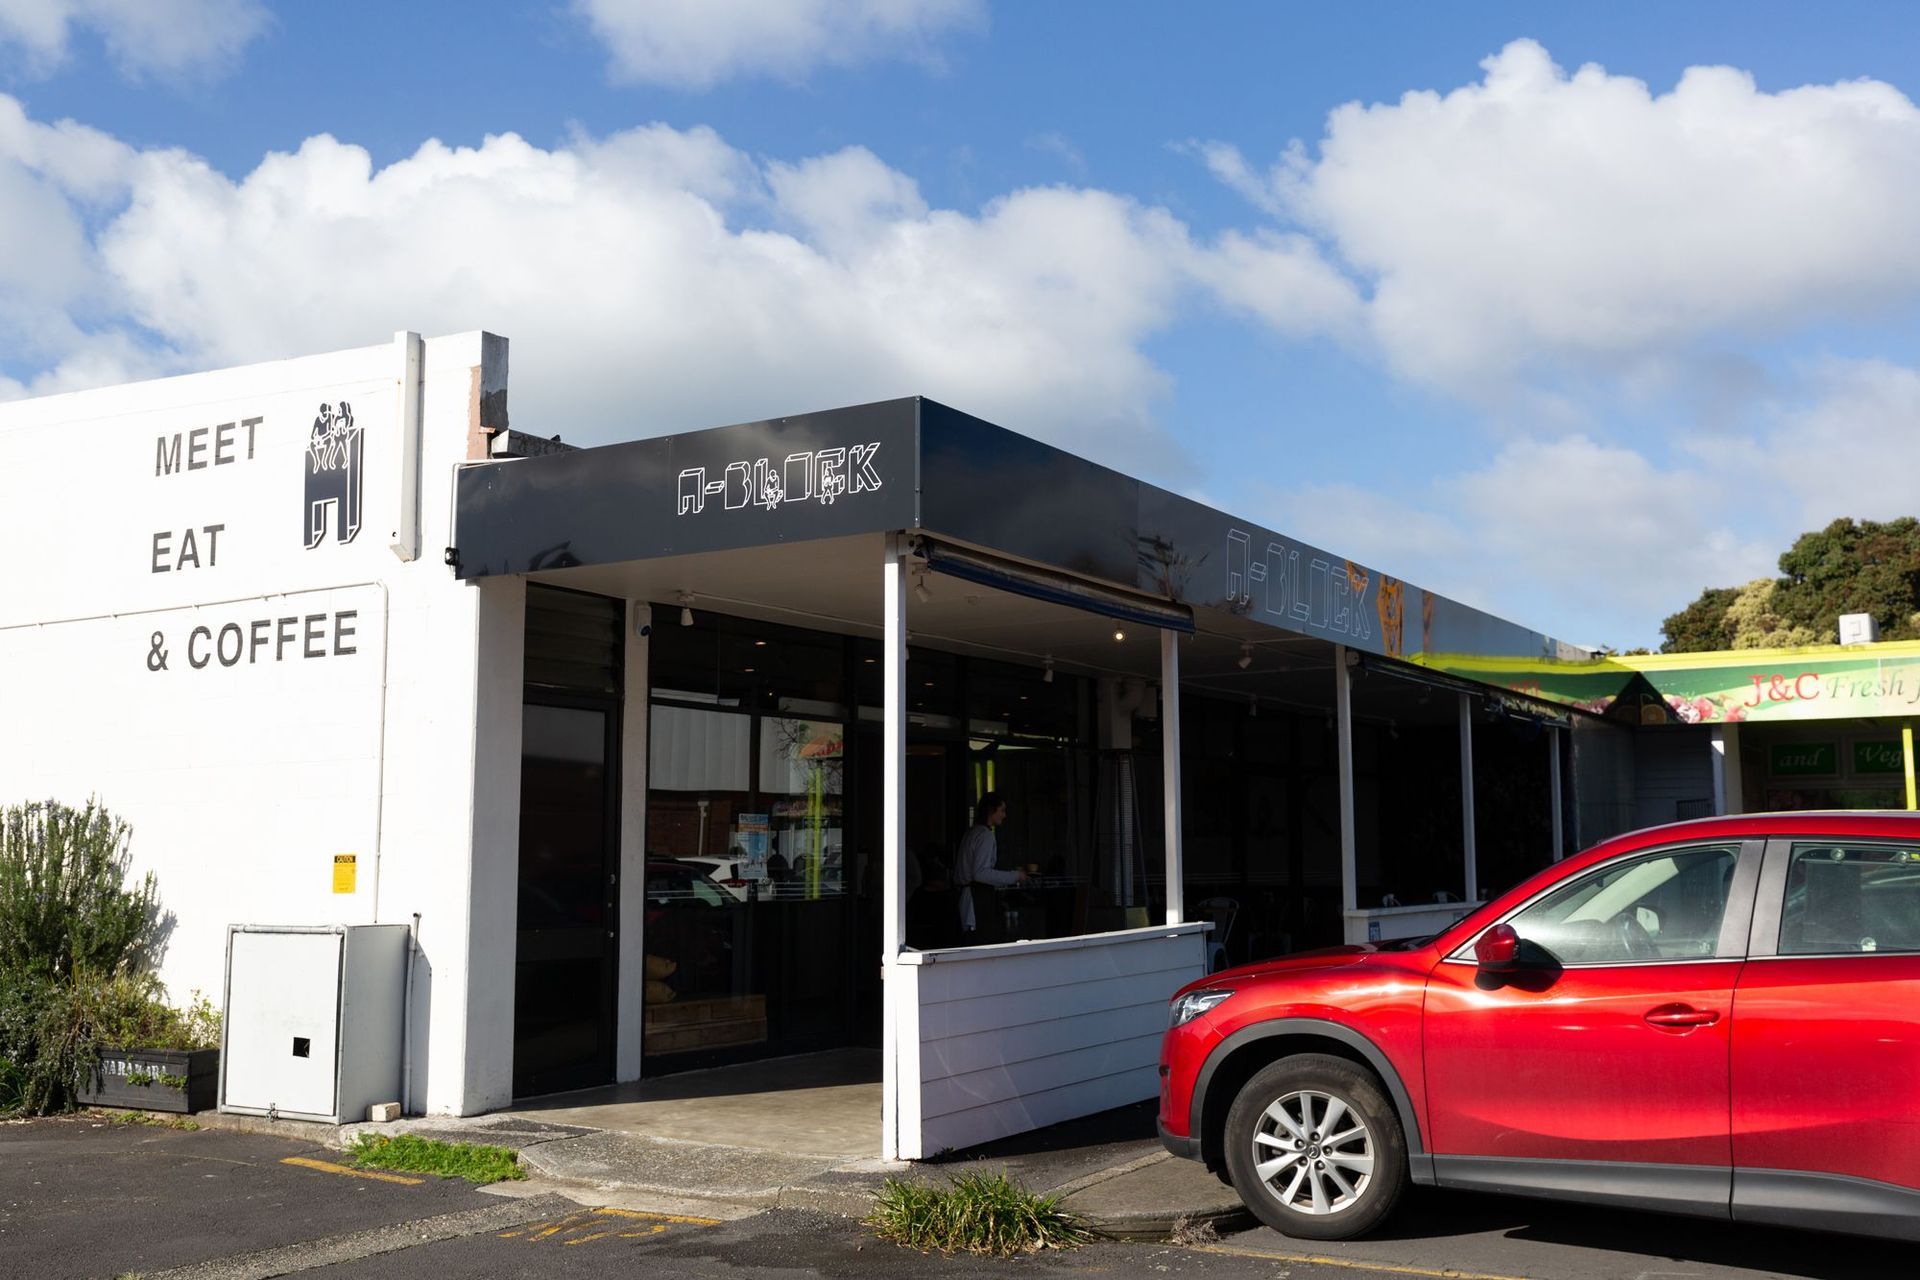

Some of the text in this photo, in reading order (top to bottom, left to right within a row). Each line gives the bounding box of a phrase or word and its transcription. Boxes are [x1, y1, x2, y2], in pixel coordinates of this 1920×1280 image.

[155, 416, 264, 477] MEET
[151, 523, 225, 574] EAT
[146, 609, 358, 672] & COFFEE
[1743, 672, 1821, 708] J&C
[1825, 668, 1905, 699] Fresh
[1780, 747, 1825, 768] and
